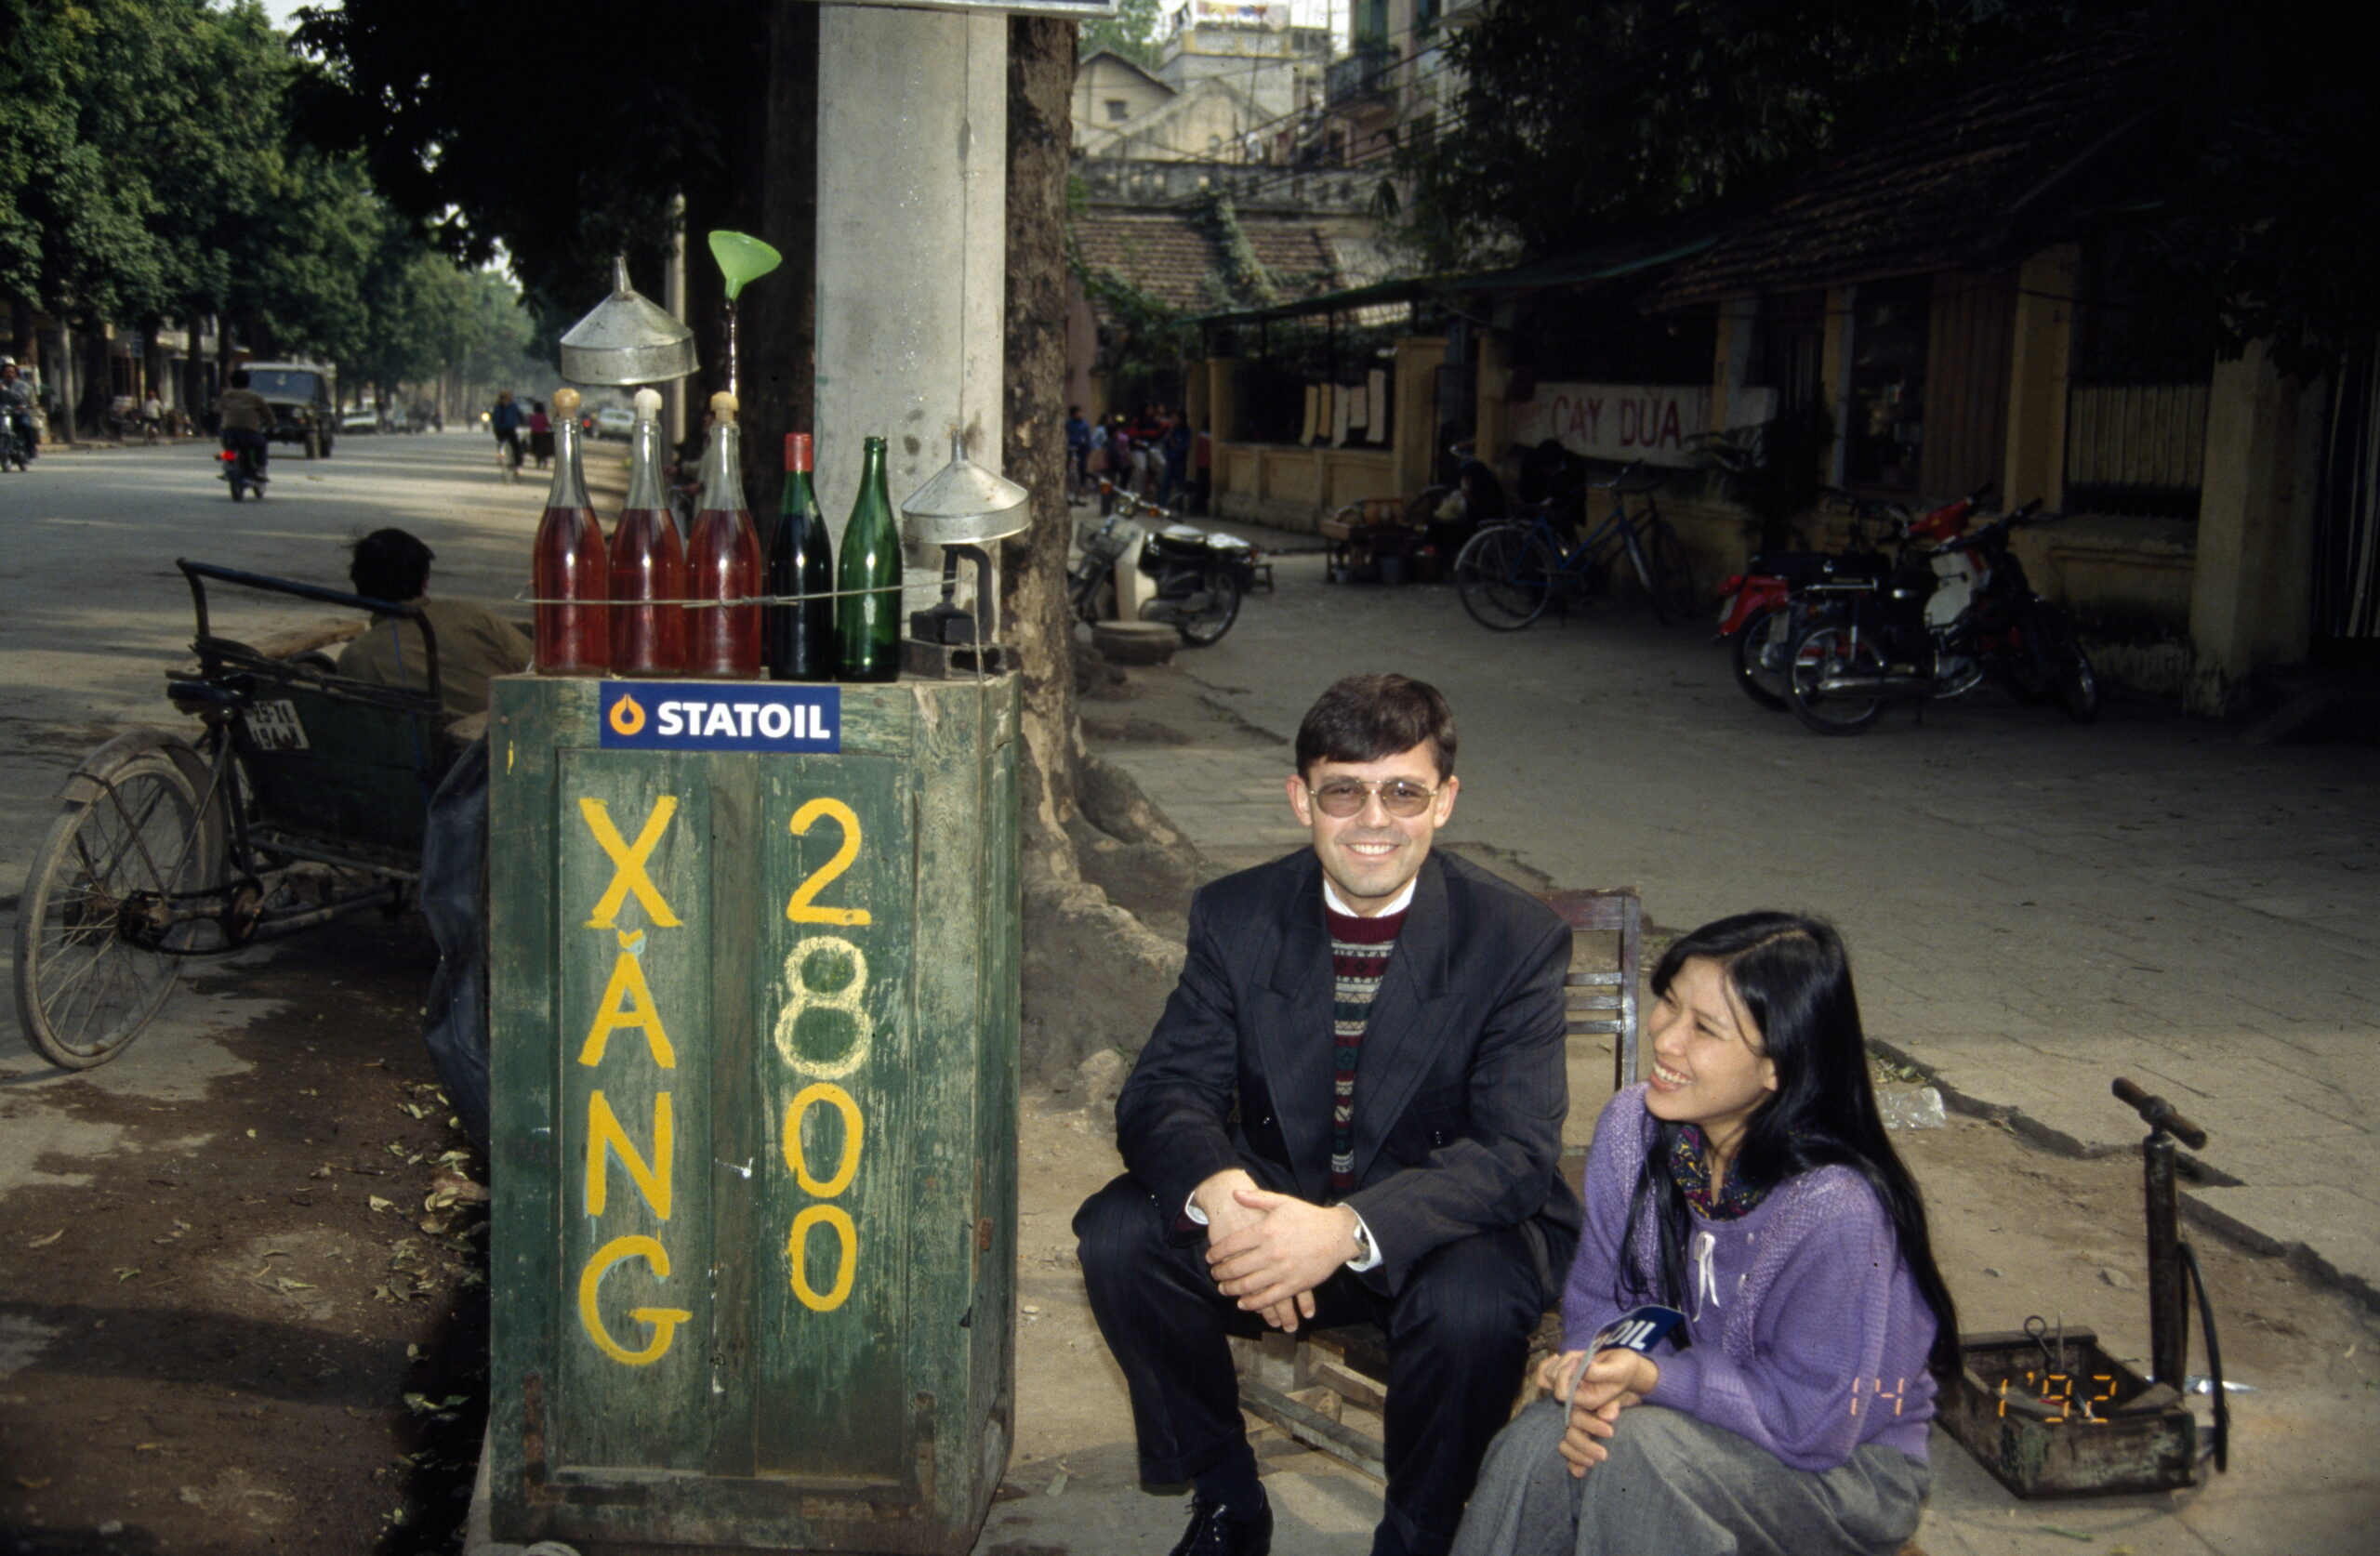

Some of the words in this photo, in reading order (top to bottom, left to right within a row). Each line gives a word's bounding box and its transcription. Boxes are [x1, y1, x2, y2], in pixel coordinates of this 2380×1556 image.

[657, 701, 831, 740] STATOIL
[774, 797, 874, 1312] 2800
[1594, 1319, 1657, 1351] OIL
